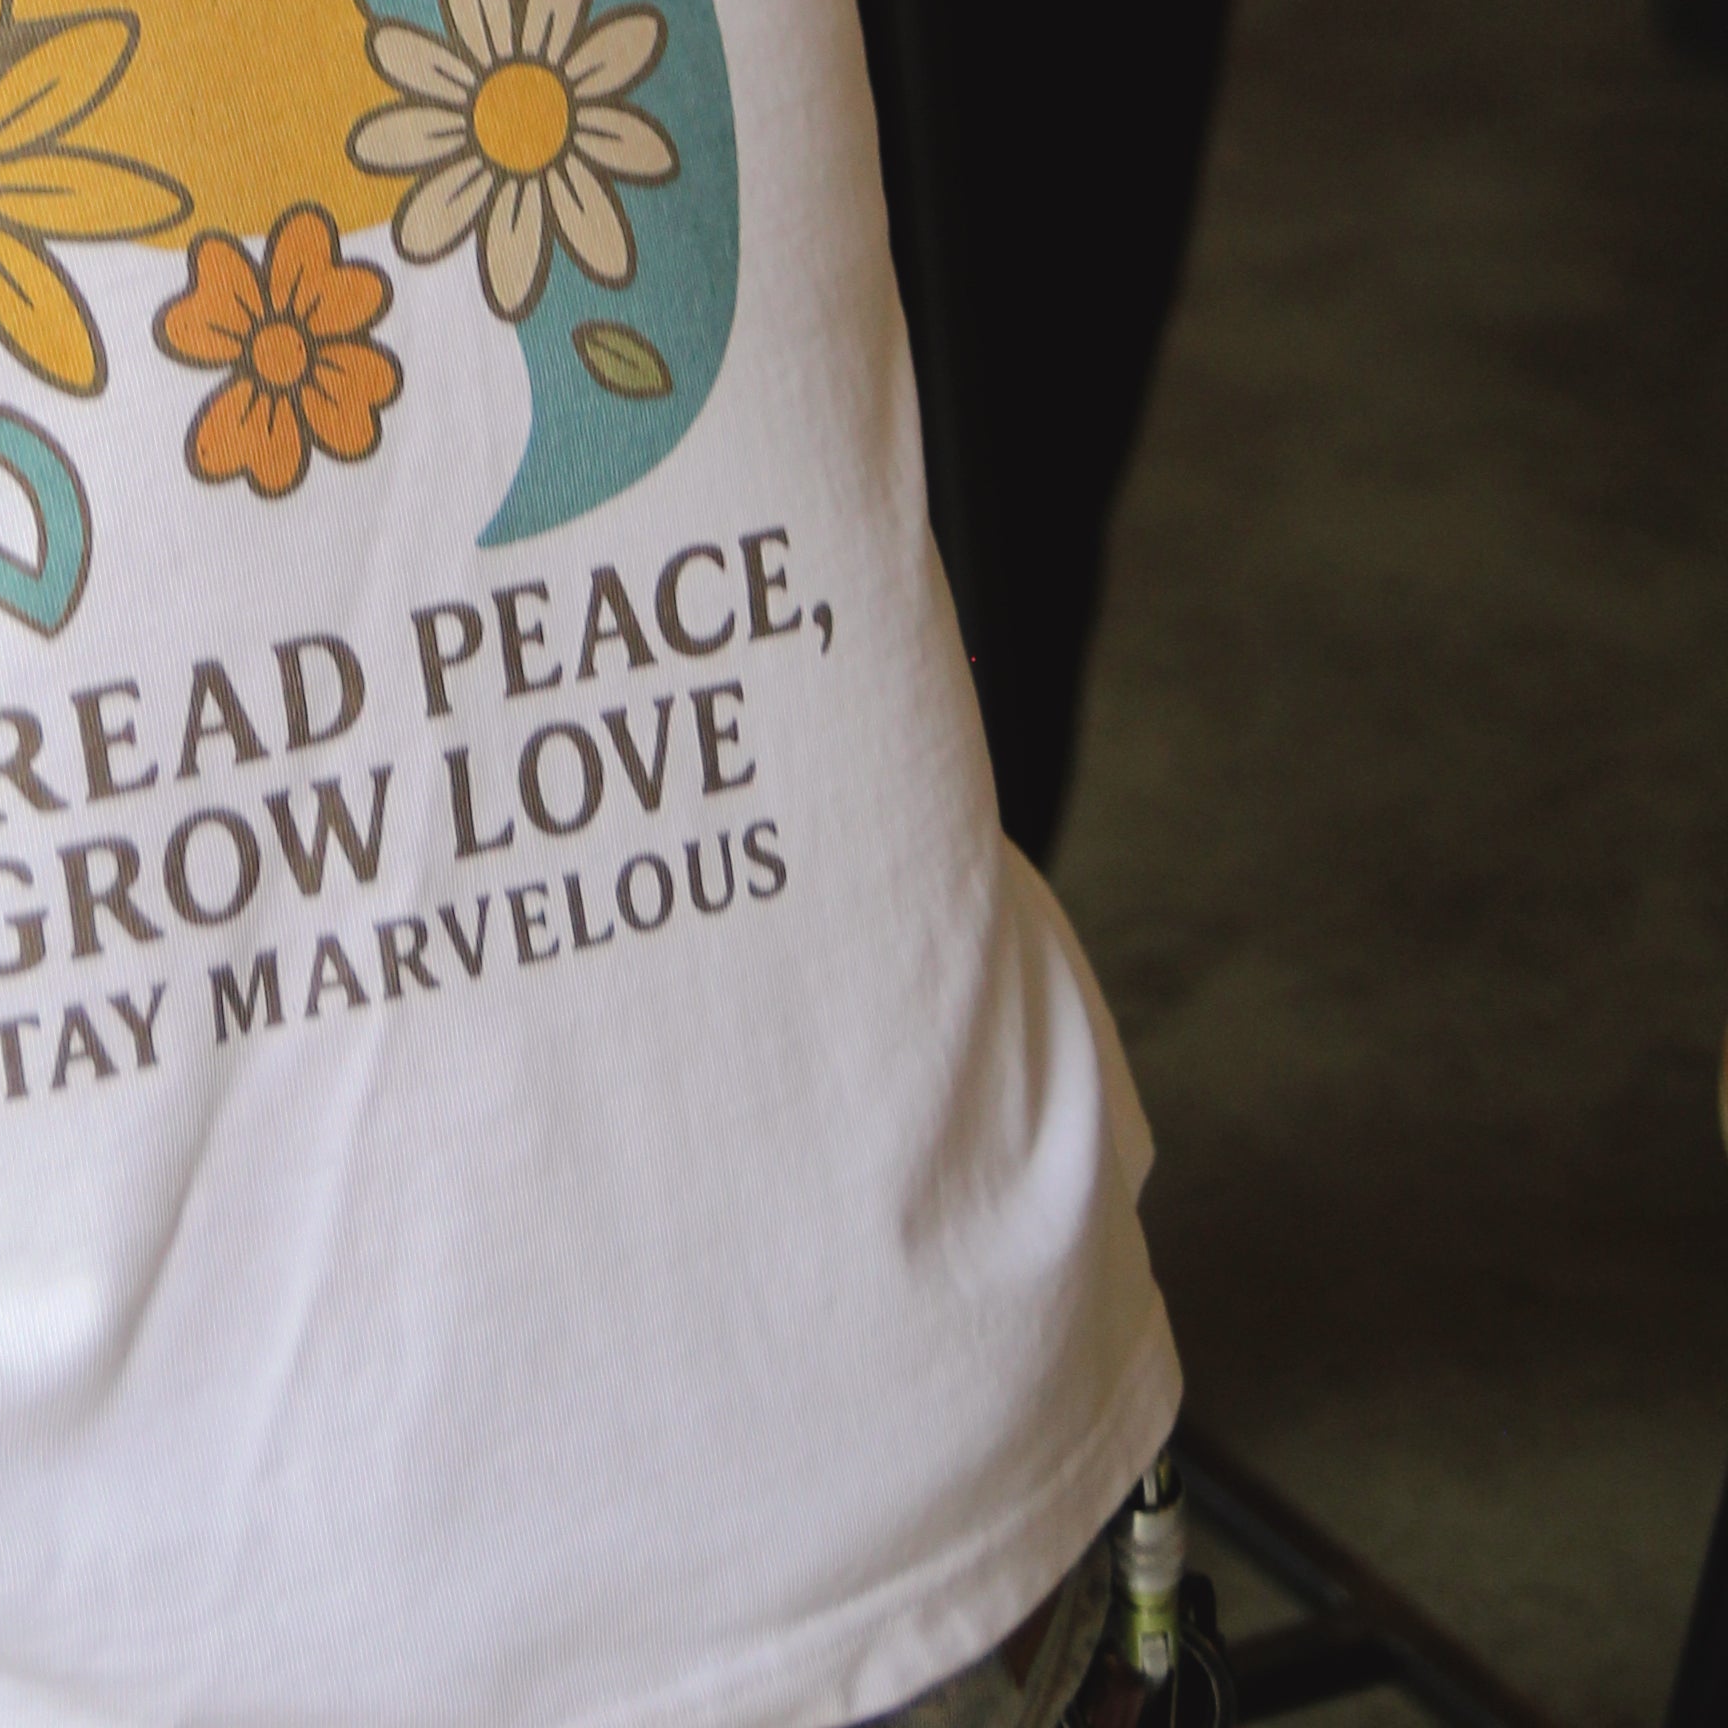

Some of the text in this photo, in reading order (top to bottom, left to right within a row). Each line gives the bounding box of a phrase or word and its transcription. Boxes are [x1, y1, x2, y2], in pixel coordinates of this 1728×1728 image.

[409, 524, 836, 722] PEACE,
[441, 678, 758, 863] LOVE
[206, 818, 789, 1050] MARVELOUS
